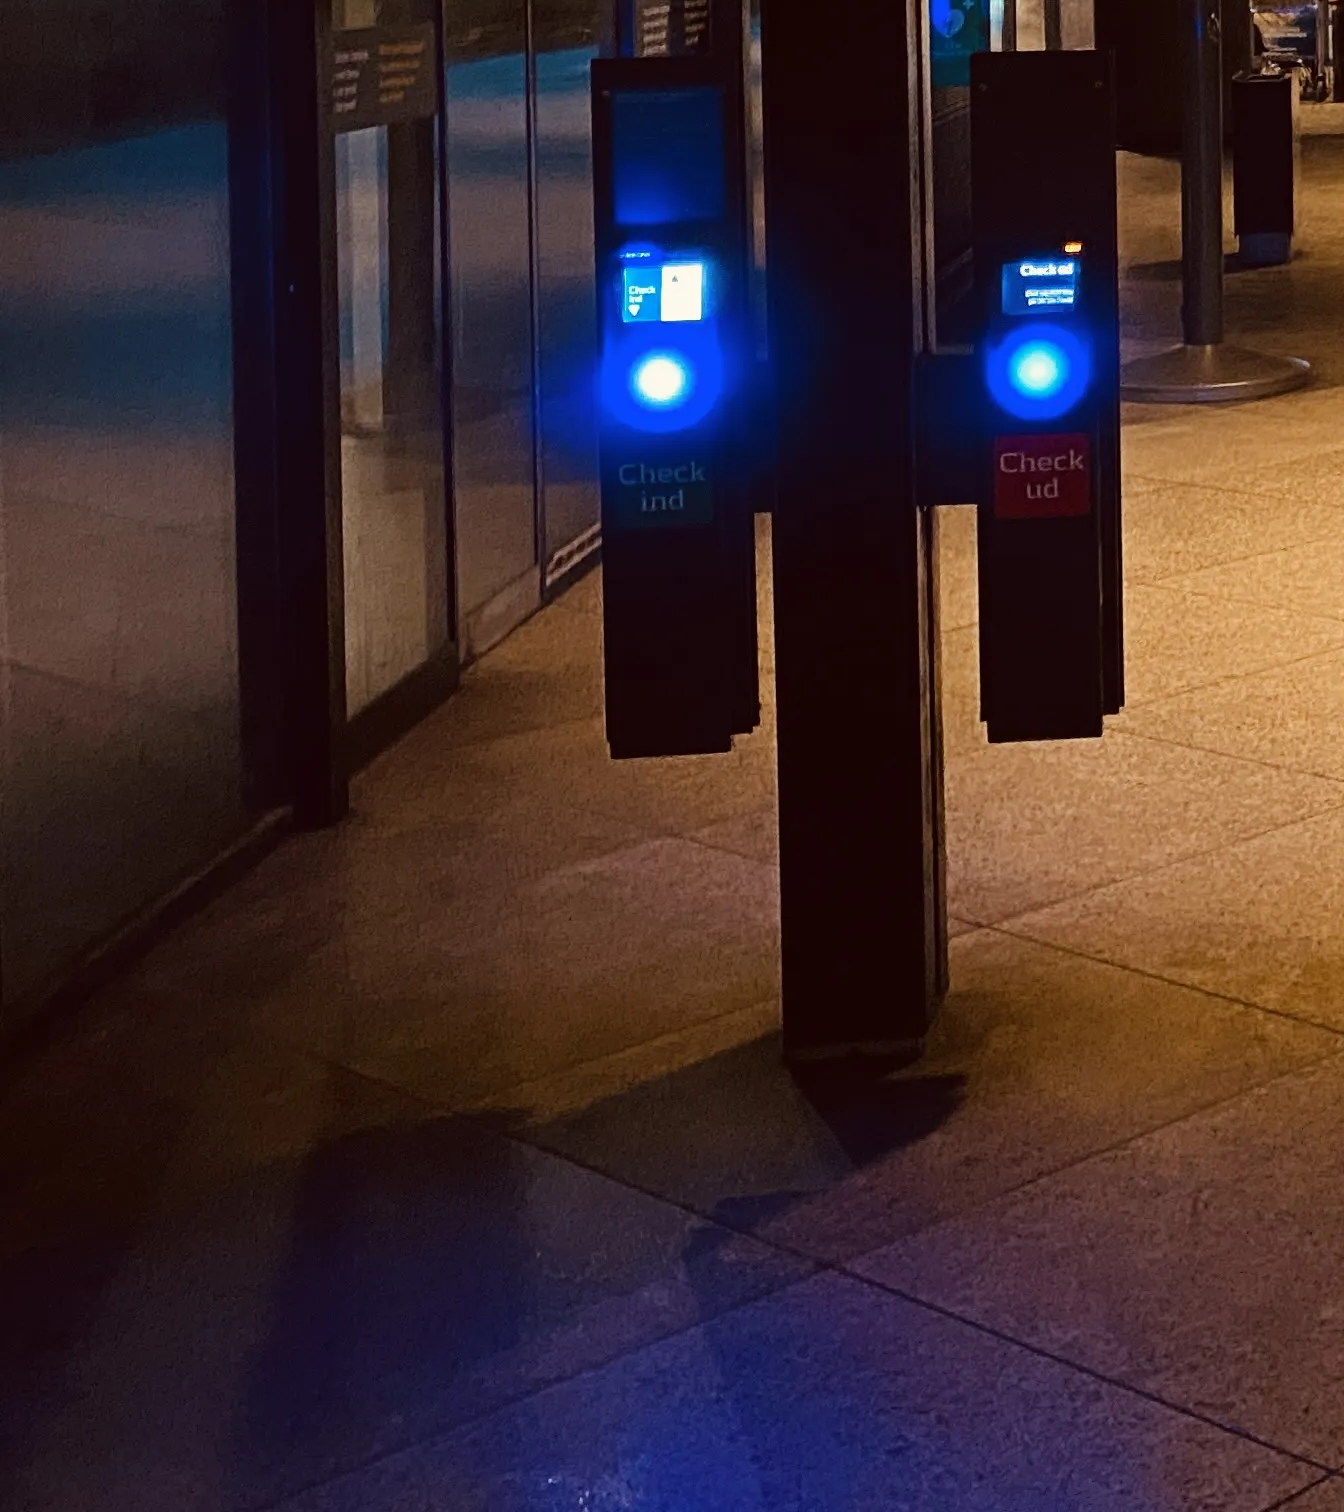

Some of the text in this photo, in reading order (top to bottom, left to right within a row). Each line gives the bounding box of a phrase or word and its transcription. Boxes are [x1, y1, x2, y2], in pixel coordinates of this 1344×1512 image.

[1019, 262, 1057, 277] Check
[618, 460, 706, 486] Check
[1000, 448, 1084, 474] Check
[641, 488, 684, 512] ind
[1026, 477, 1059, 500] ud
